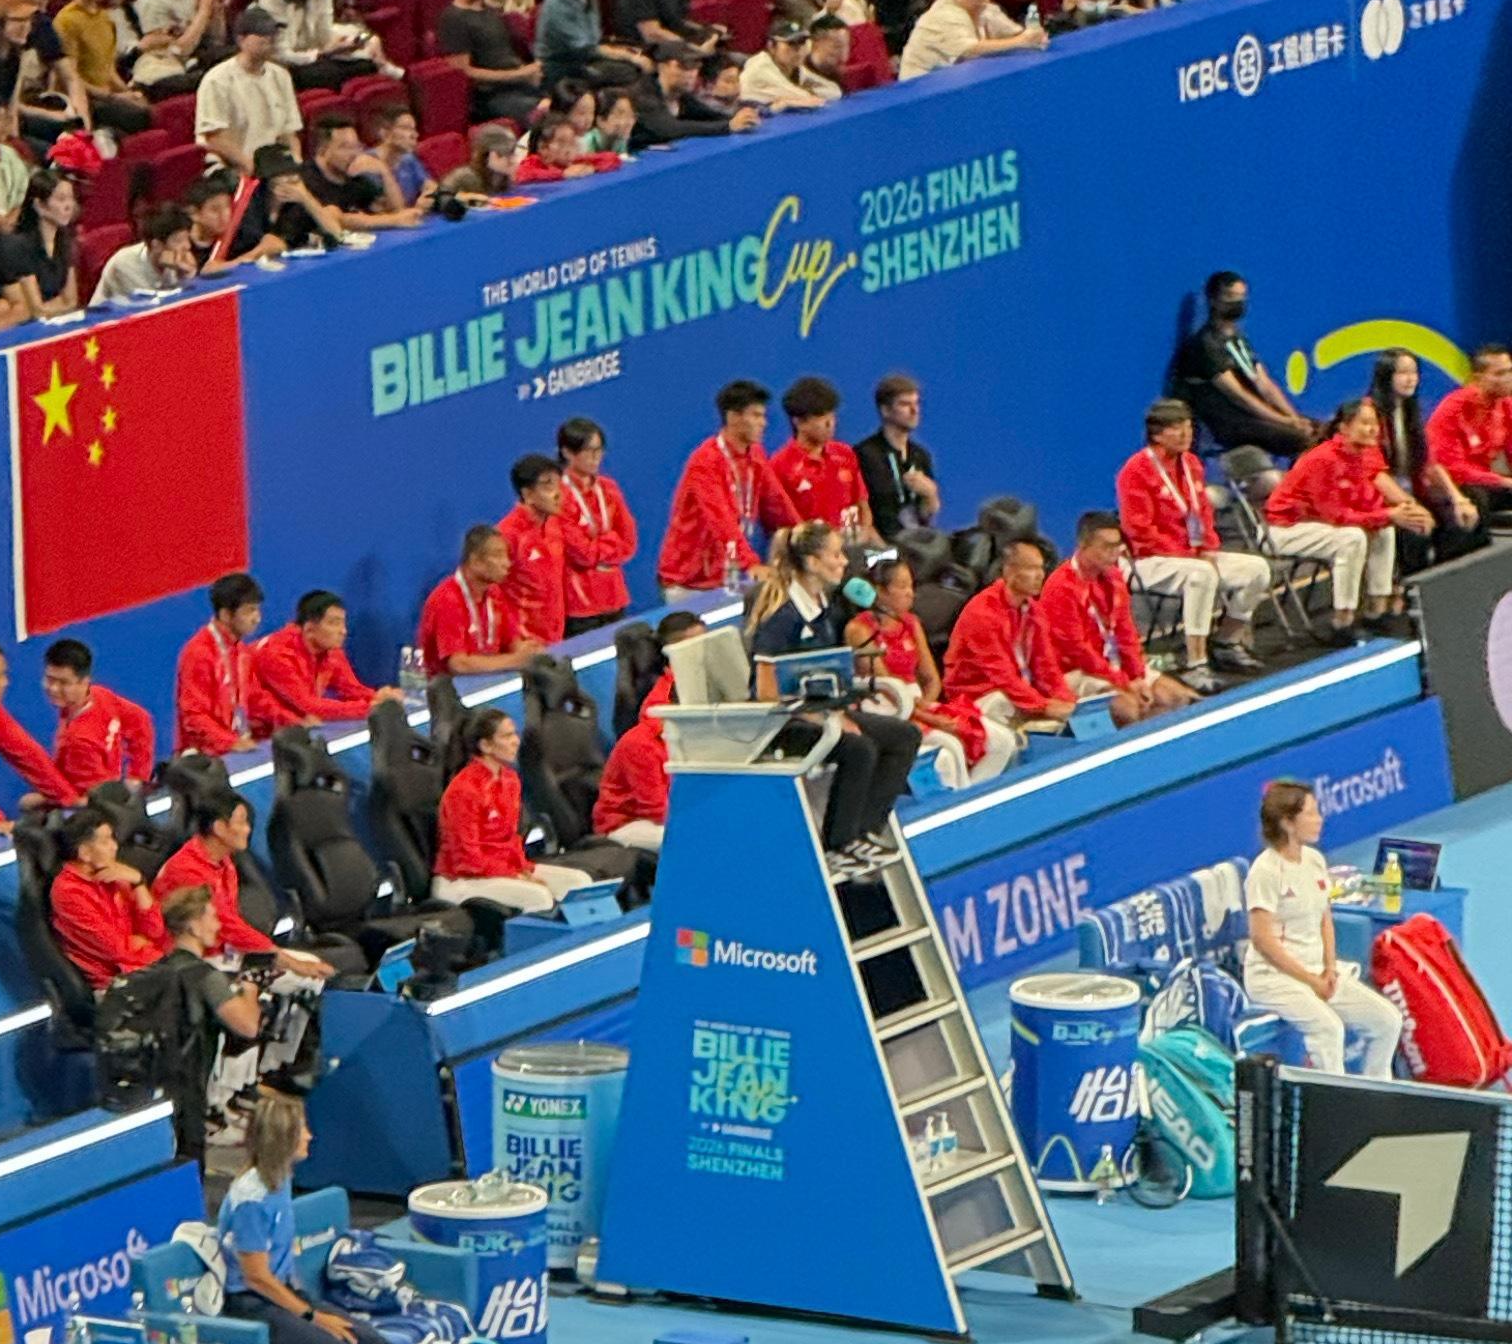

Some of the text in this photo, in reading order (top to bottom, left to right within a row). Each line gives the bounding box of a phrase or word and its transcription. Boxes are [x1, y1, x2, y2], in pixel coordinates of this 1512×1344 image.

[1178, 54, 1228, 103] ICBC
[859, 149, 1019, 235] 2026 FINALS
[861, 201, 1021, 294] SHENZHEN
[482, 234, 658, 307] THE WORLD CUP OF TENNIS
[371, 194, 858, 417] BILLIE JEAN KING Cup
[986, 853, 1089, 957] ZONE
[714, 939, 818, 976] Microsoft
[693, 1029, 791, 1069] BILLIE
[692, 1059, 788, 1097] JEAN
[530, 1097, 582, 1117] YONEX
[506, 1133, 583, 1160] BILLIE
[688, 1153, 784, 1182] SHENZHEN
